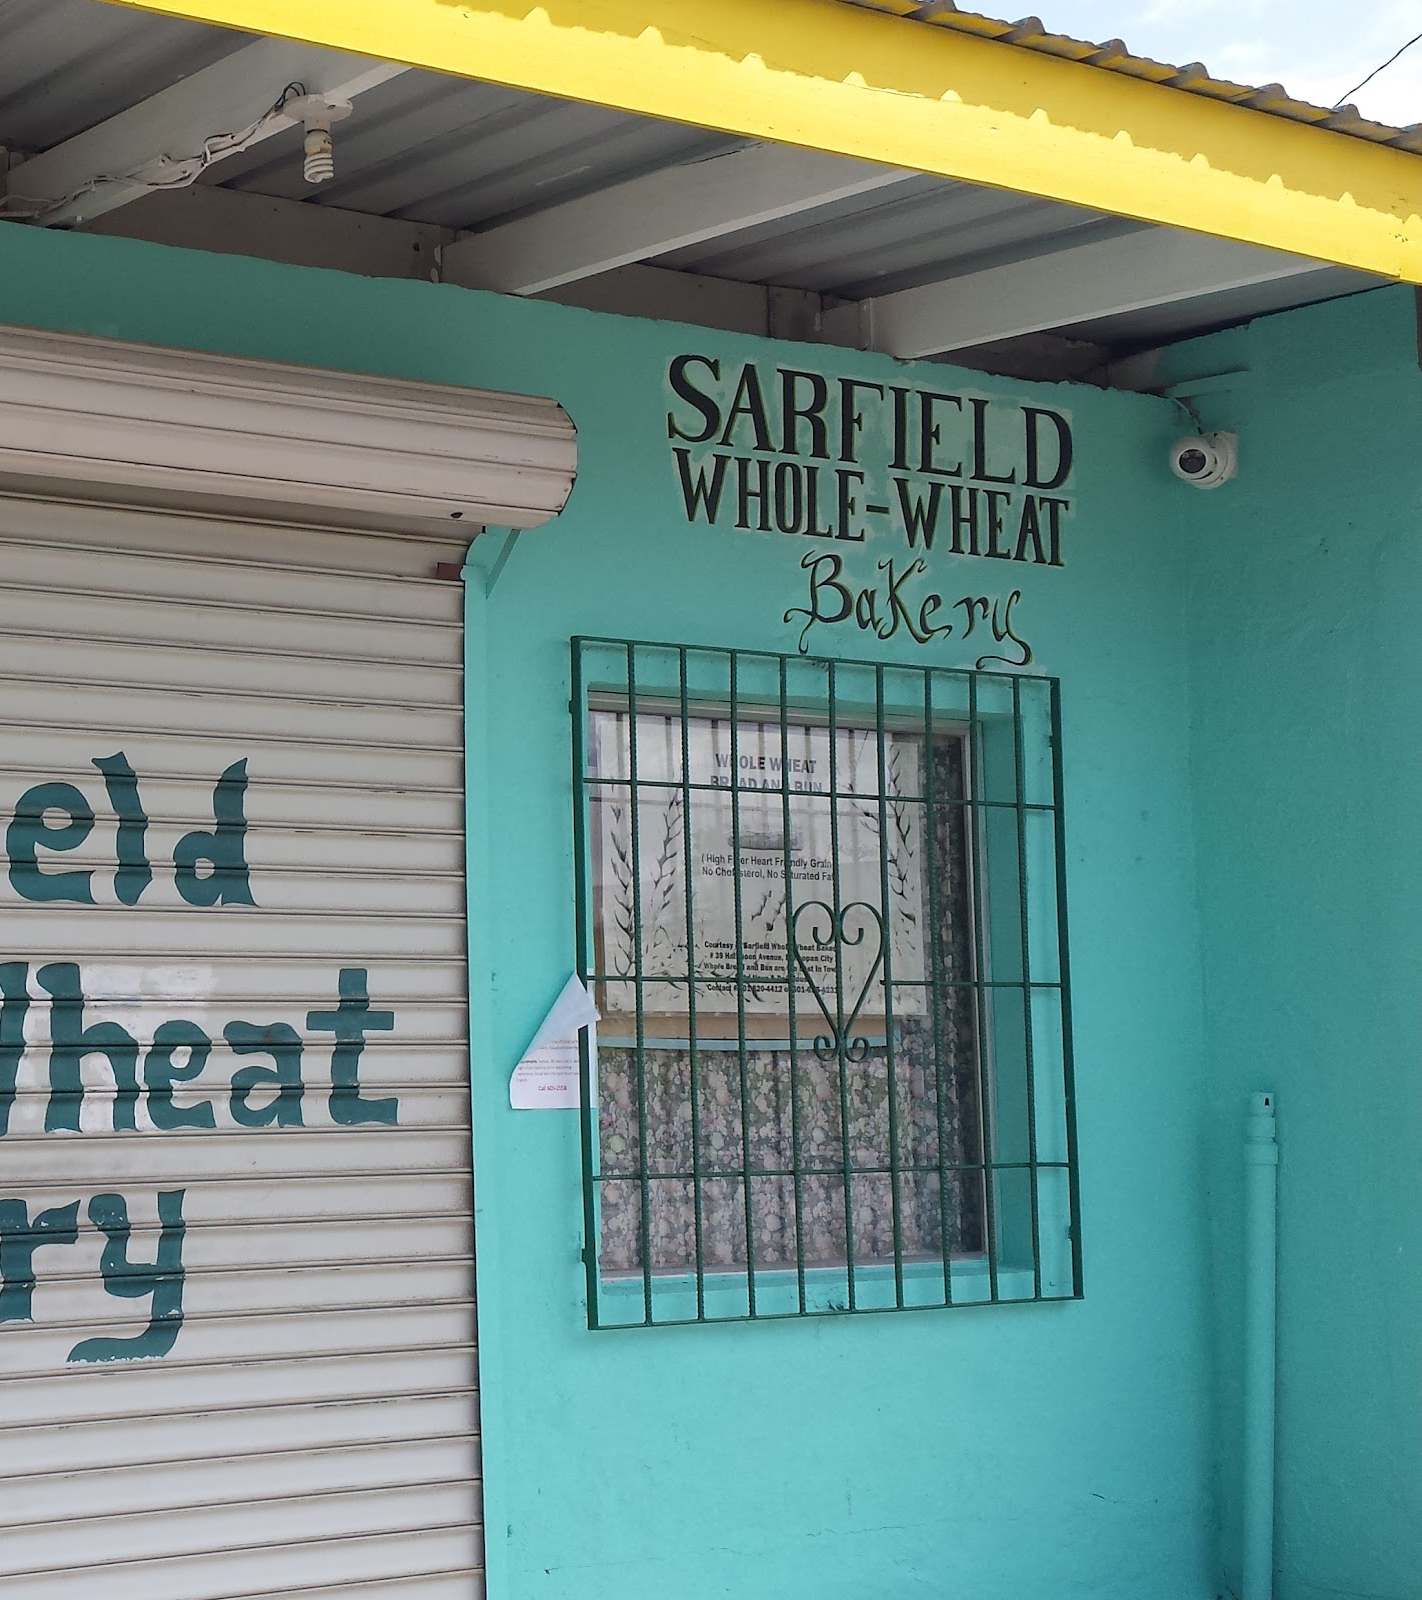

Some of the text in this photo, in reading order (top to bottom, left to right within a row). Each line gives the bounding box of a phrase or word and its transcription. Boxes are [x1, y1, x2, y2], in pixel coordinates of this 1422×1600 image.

[667, 354, 1073, 489] SARFIELD
[672, 447, 1070, 567] WHOLE-WHEAT
[716, 753, 765, 770] WOLE
[710, 776, 757, 789] BRAD
[707, 854, 726, 866] High
[727, 855, 749, 865] Fer
[751, 856, 773, 866] Heart
[775, 857, 808, 869] Frndly
[702, 866, 714, 876] No
[715, 867, 764, 879] Chosterol,
[767, 870, 779, 879] No
[780, 870, 820, 881] Surated
[704, 941, 734, 951] Courtesy
